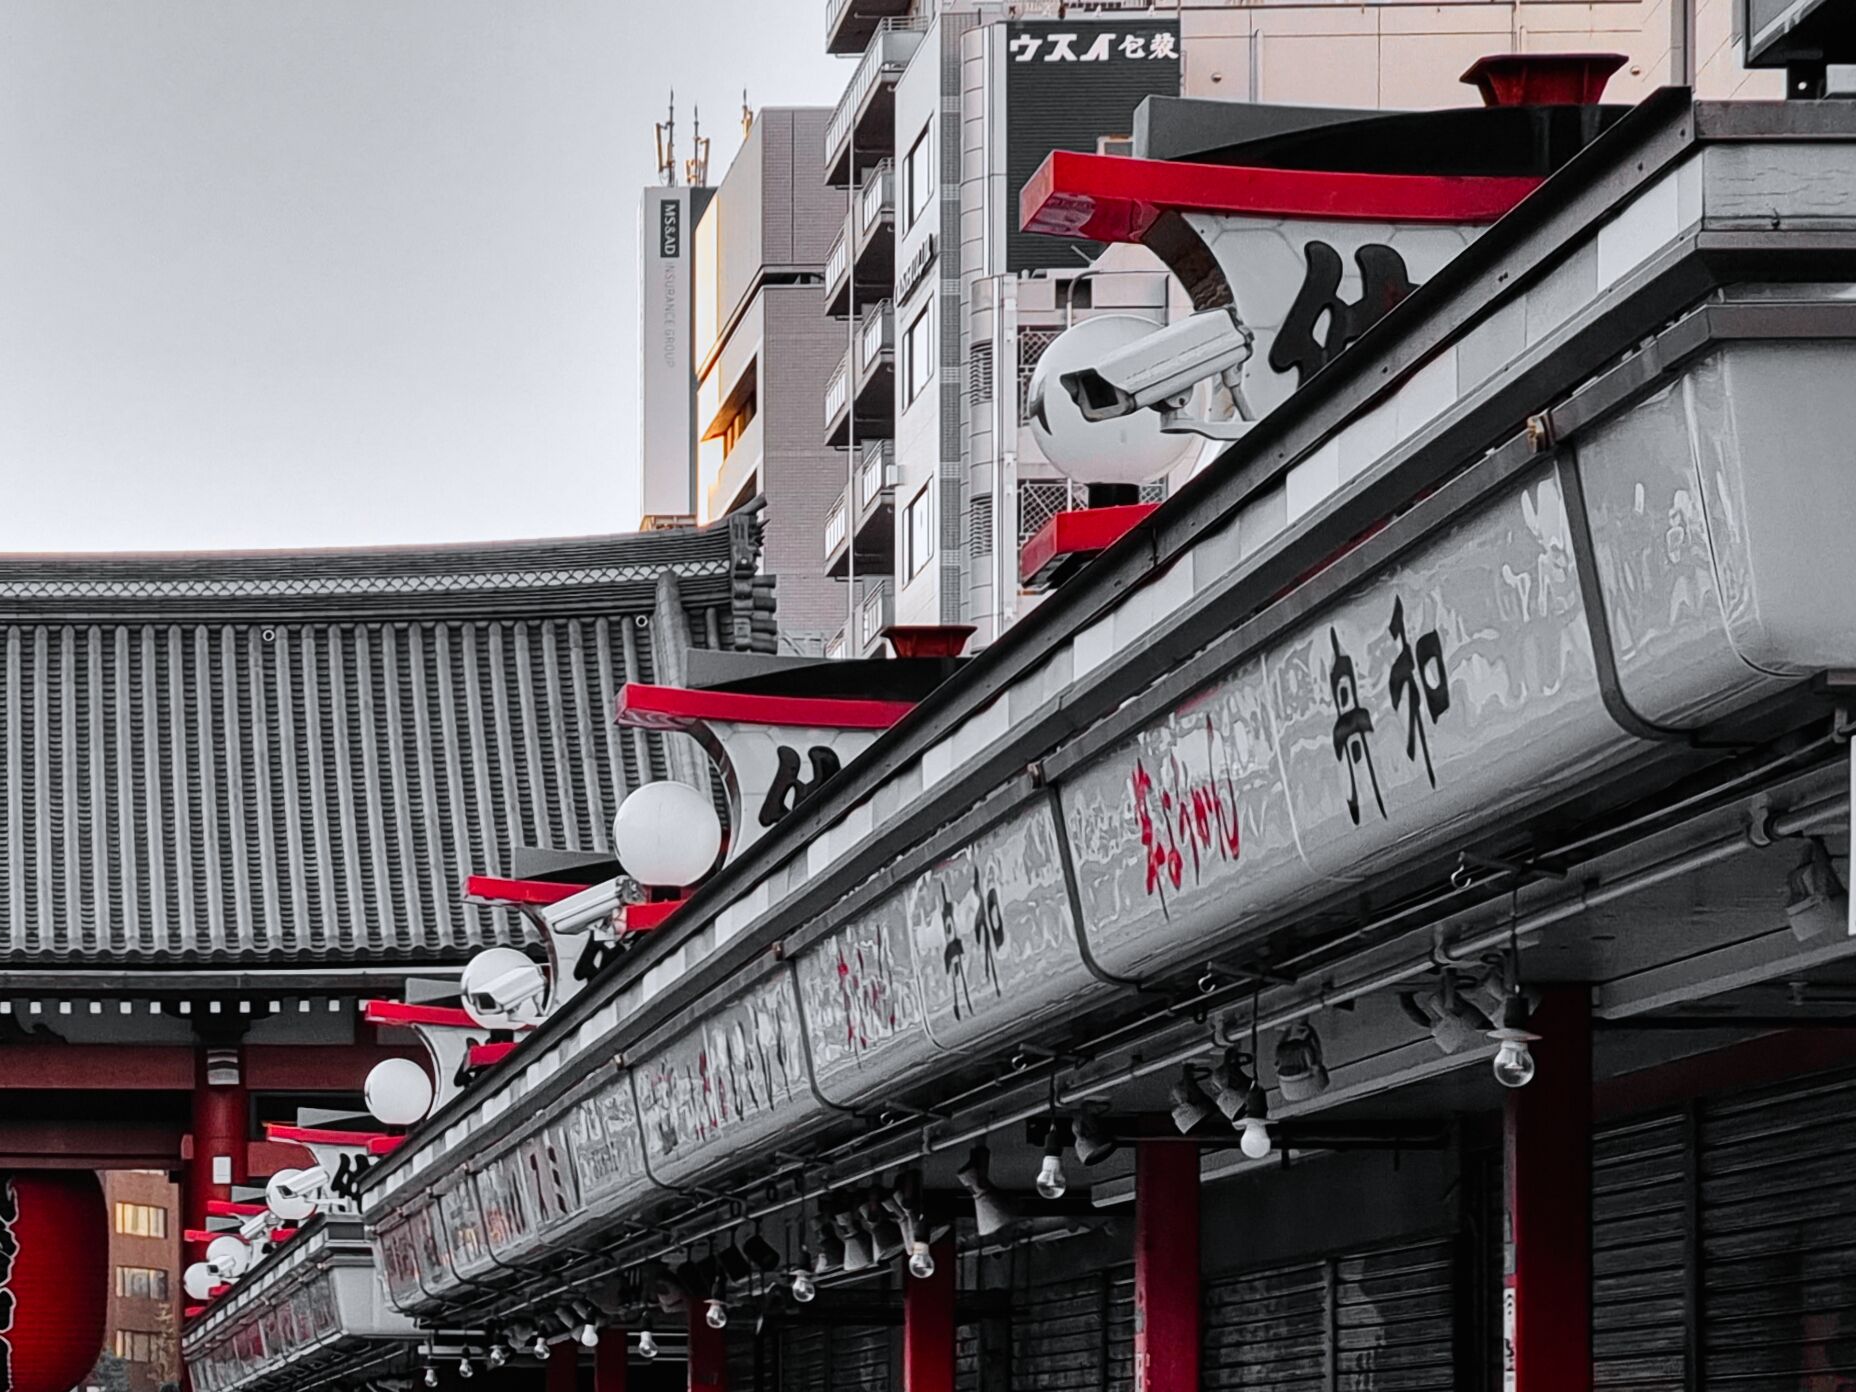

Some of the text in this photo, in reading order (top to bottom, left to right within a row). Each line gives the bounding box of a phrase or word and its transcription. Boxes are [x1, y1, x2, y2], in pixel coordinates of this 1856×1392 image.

[1009, 32, 1179, 62] ウスイ包装
[663, 203, 676, 369] MS&AD INSURANCE GROUP
